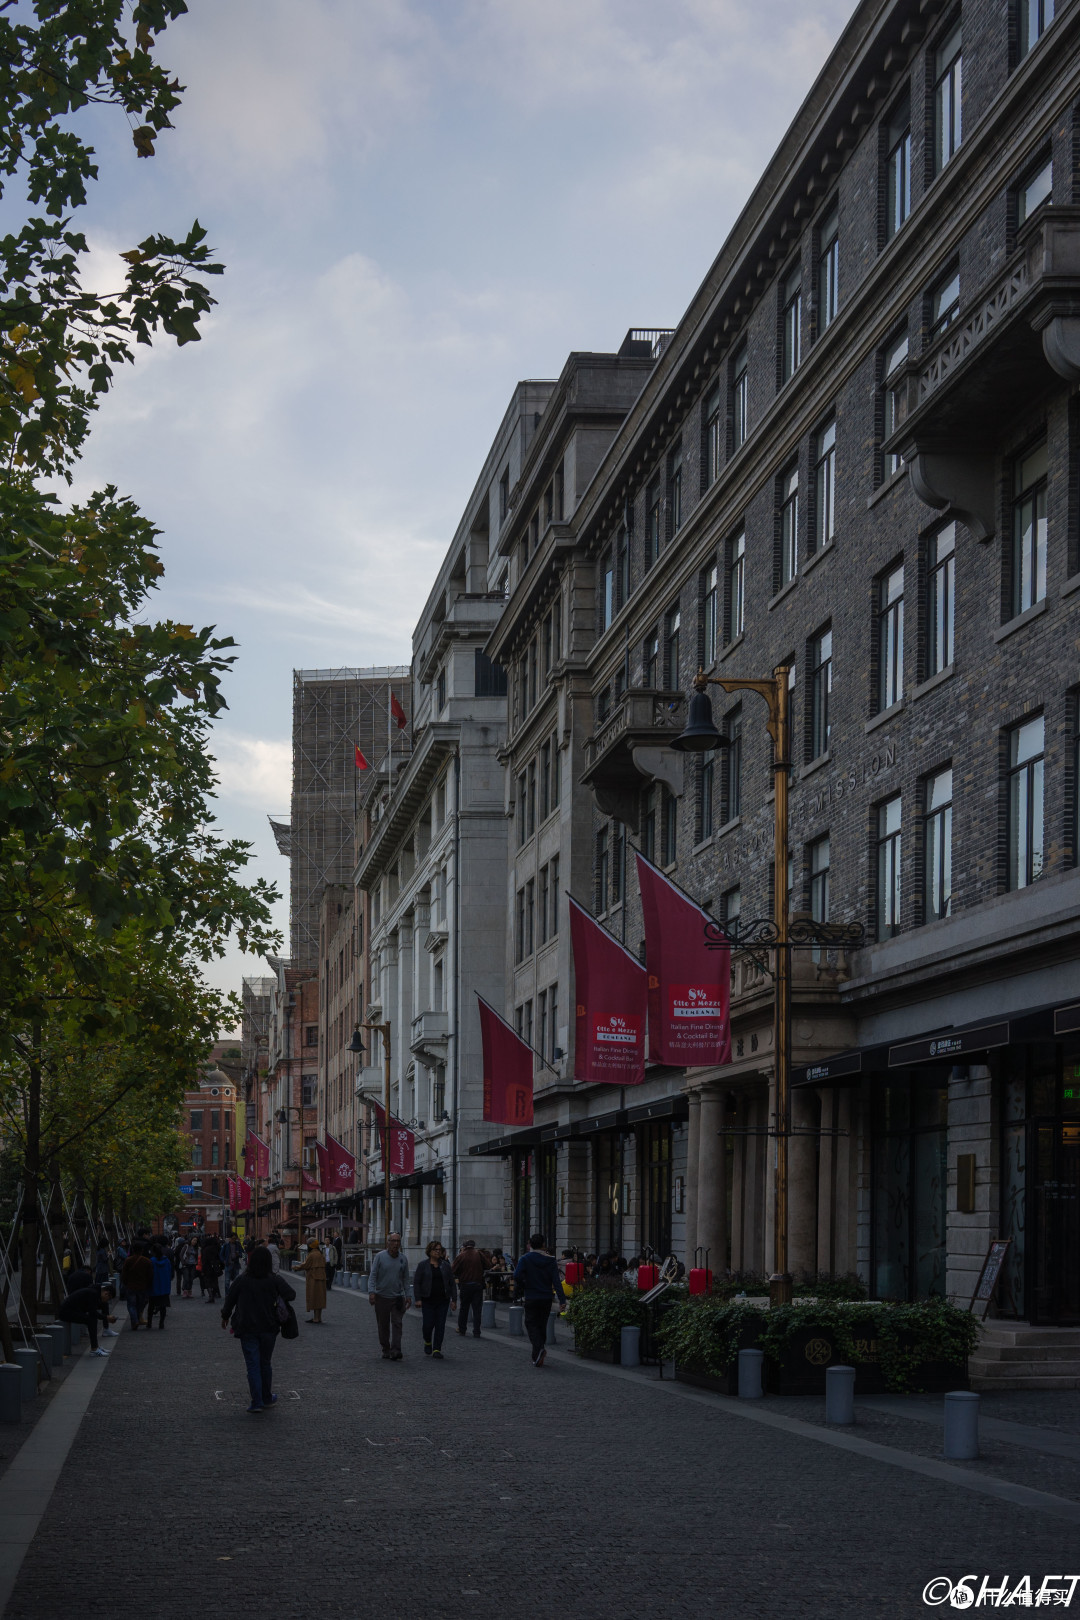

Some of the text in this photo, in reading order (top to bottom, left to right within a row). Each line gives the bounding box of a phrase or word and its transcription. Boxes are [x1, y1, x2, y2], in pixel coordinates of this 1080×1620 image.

[723, 743, 897, 870] ASSOCITE MISSION
[673, 999, 690, 1007] Otto
[704, 1023, 725, 1031] Dining
[682, 1032, 708, 1040] Cocktail
